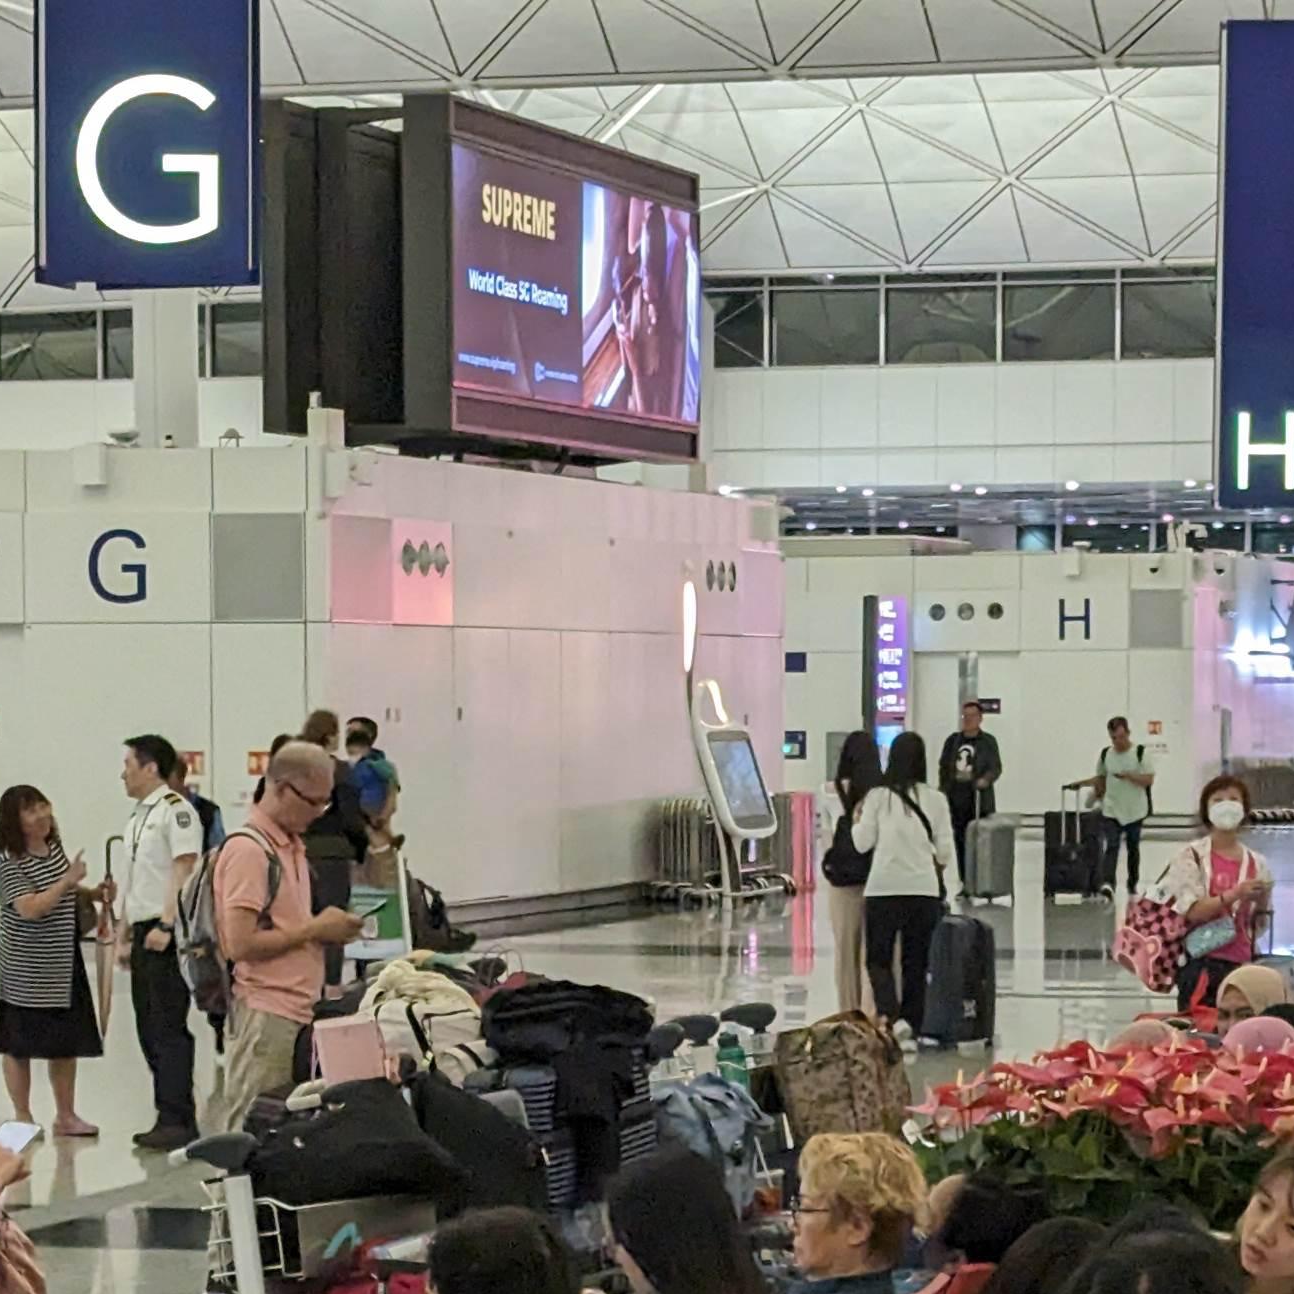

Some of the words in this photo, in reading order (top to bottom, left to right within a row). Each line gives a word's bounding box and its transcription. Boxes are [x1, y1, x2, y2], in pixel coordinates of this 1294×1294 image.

[75, 73, 220, 245] G
[481, 183, 556, 240] SUPREME
[468, 268, 495, 295] World
[496, 275, 518, 300] Class
[531, 283, 568, 315] Roaming
[87, 528, 147, 603] G
[1058, 598, 1091, 640] H
